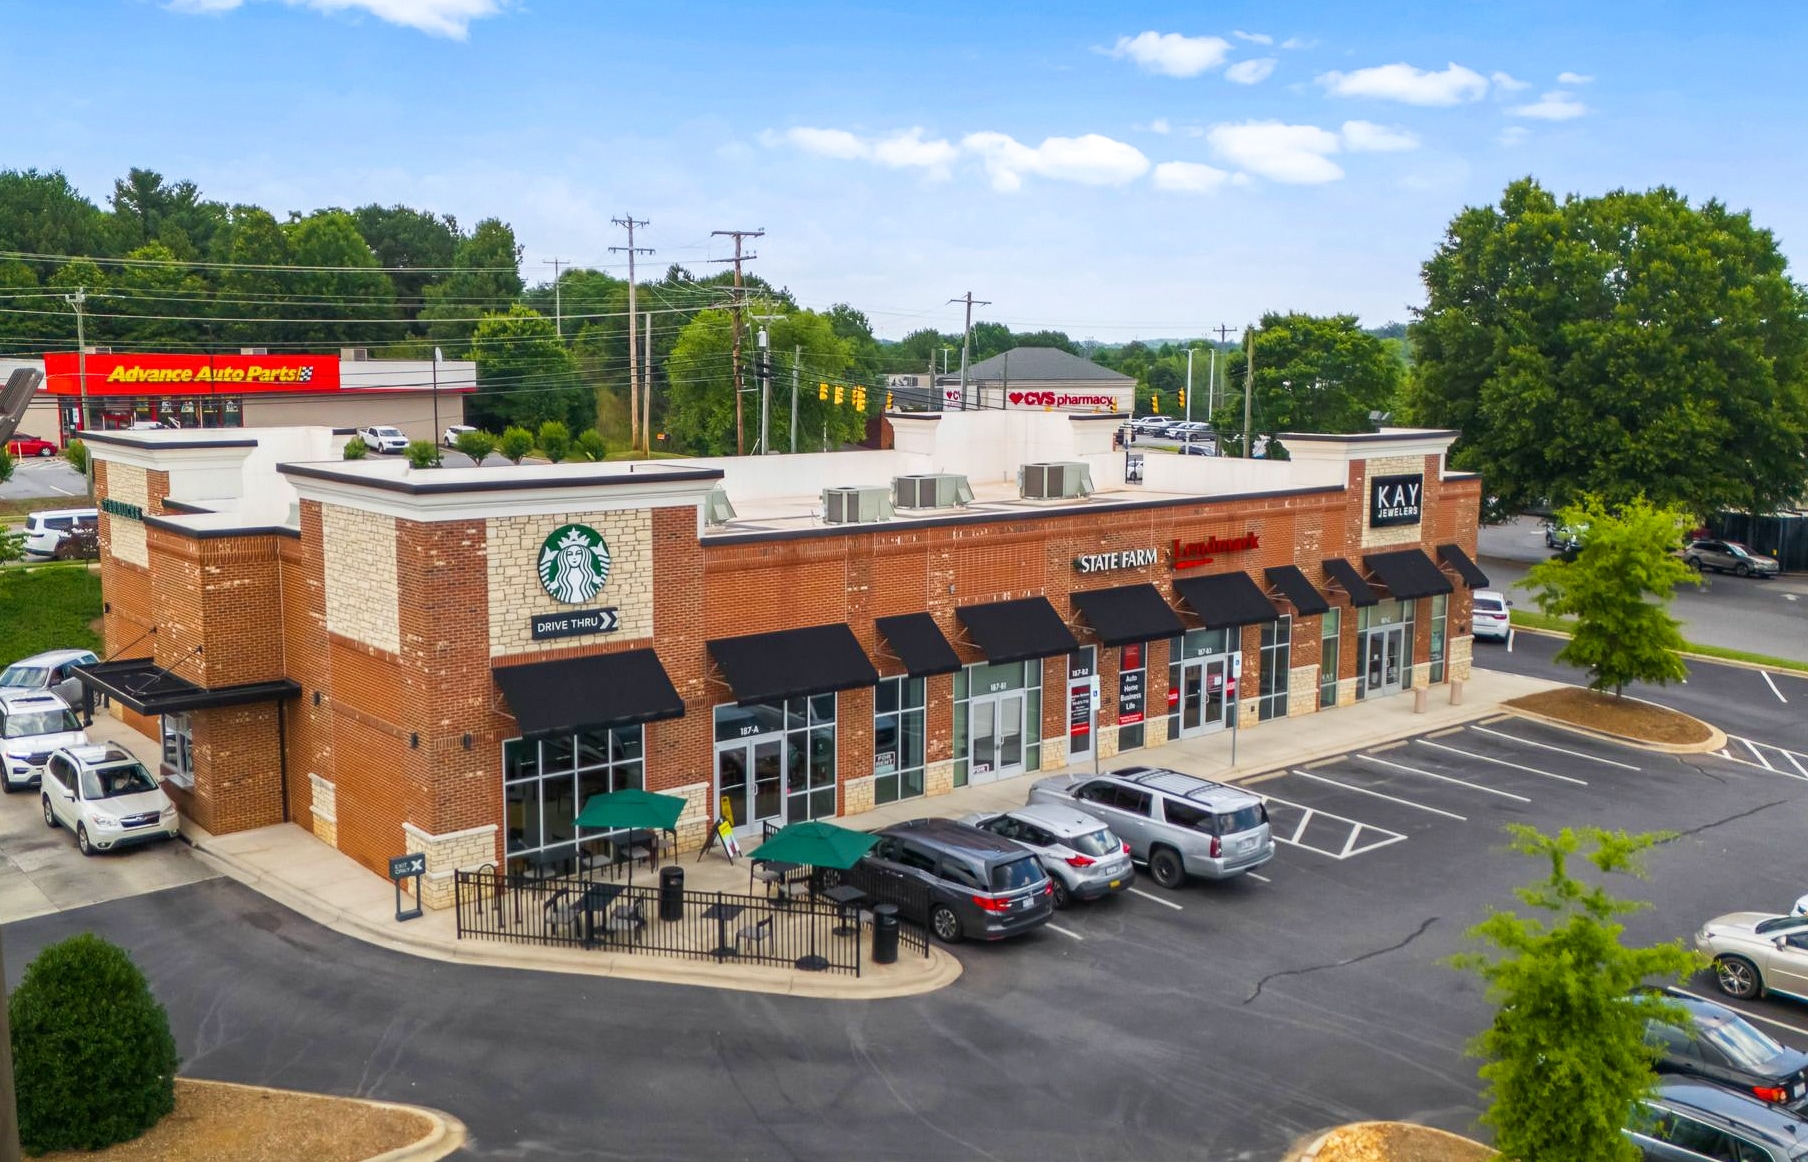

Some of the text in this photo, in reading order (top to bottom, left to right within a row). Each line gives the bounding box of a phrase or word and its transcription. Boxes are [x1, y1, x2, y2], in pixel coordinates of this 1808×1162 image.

[107, 366, 297, 382] Advance Auto Parts
[1023, 391, 1113, 407] CVS pharmacy
[1378, 483, 1419, 508] KAY
[1377, 506, 1418, 518] JEWELERS
[1081, 548, 1157, 573] STATE FARM
[537, 617, 598, 633] DRIVE THRU
[740, 725, 760, 736] 187-A
